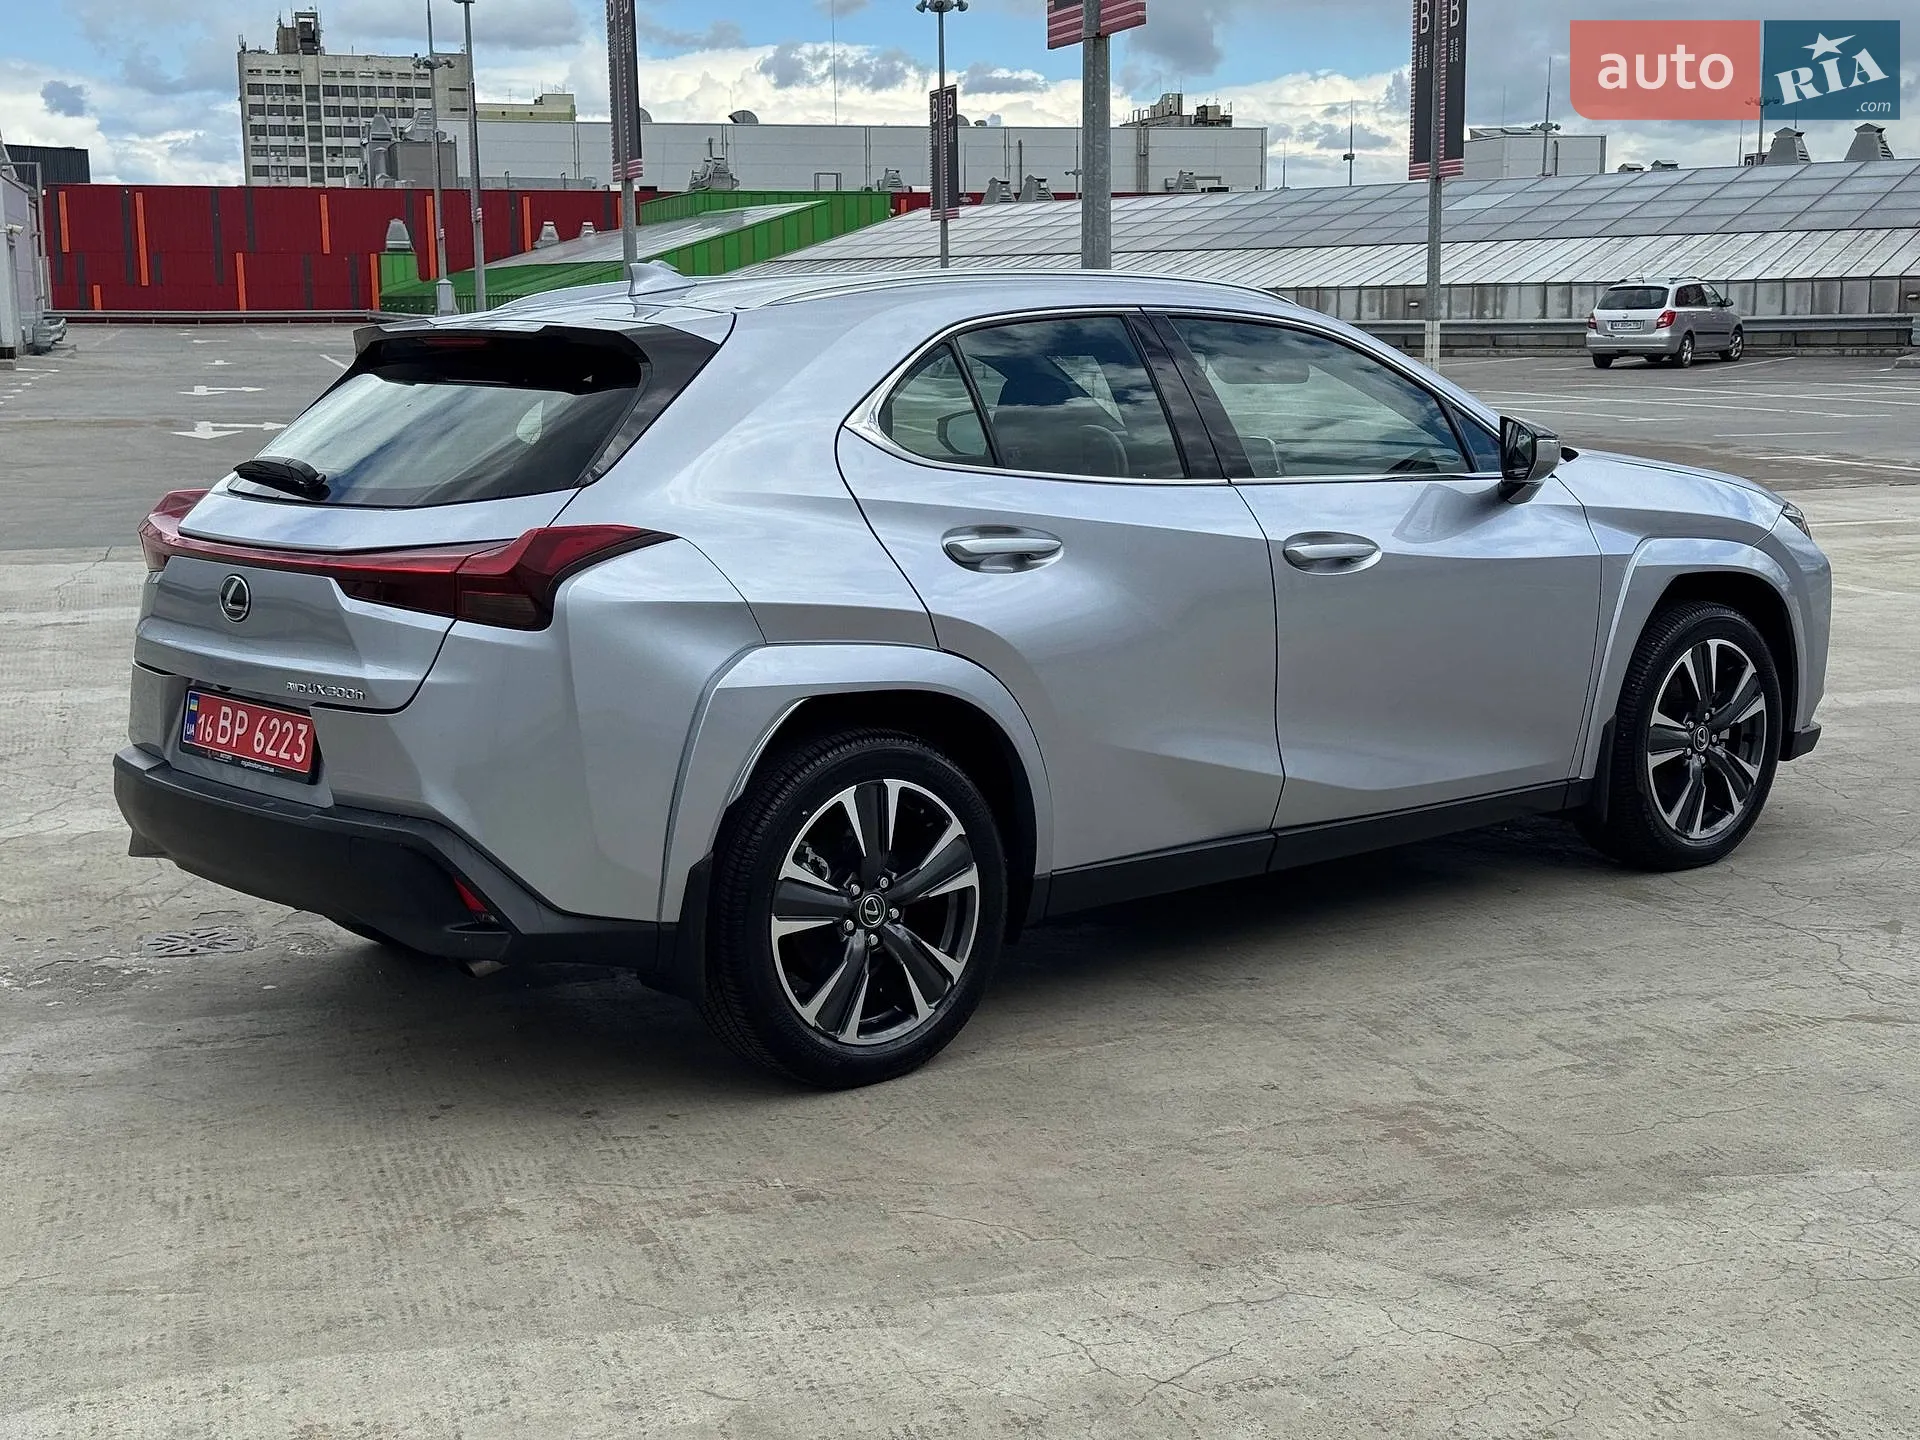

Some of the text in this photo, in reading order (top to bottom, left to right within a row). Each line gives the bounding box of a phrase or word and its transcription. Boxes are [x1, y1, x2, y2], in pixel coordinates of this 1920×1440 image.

[1420, 0, 1430, 34] B
[932, 98, 938, 123] B
[947, 94, 953, 120] B
[186, 723, 195, 736] UA
[198, 713, 214, 743] 16
[253, 715, 309, 763] 6223
